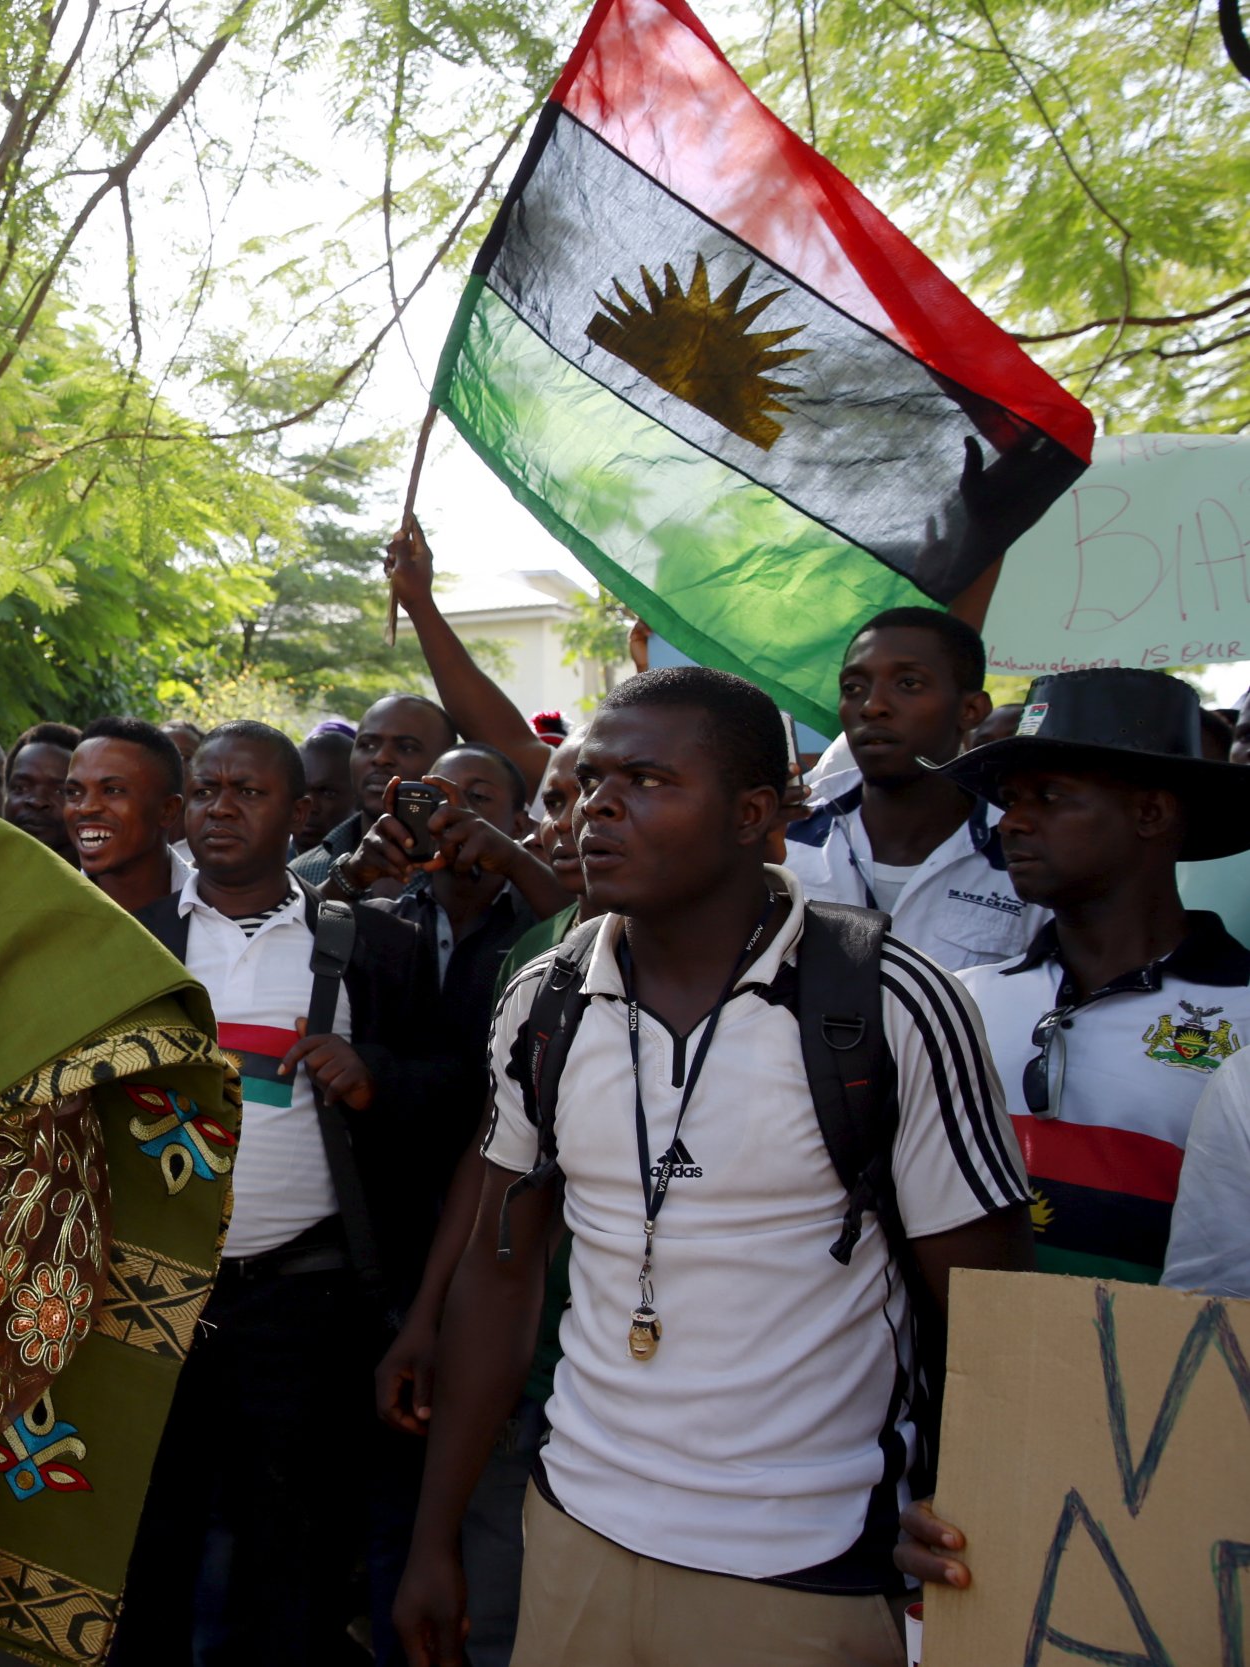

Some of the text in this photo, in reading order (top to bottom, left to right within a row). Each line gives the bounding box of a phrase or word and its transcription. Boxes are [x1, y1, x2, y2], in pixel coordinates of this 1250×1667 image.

[1059, 484, 1250, 633] BIA
[1140, 643, 1169, 667] IS
[1181, 639, 1246, 663] OUR
[745, 924, 764, 951] NOKIA
[649, 1163, 703, 1178] aidas
[657, 1160, 671, 1192] NOKIA
